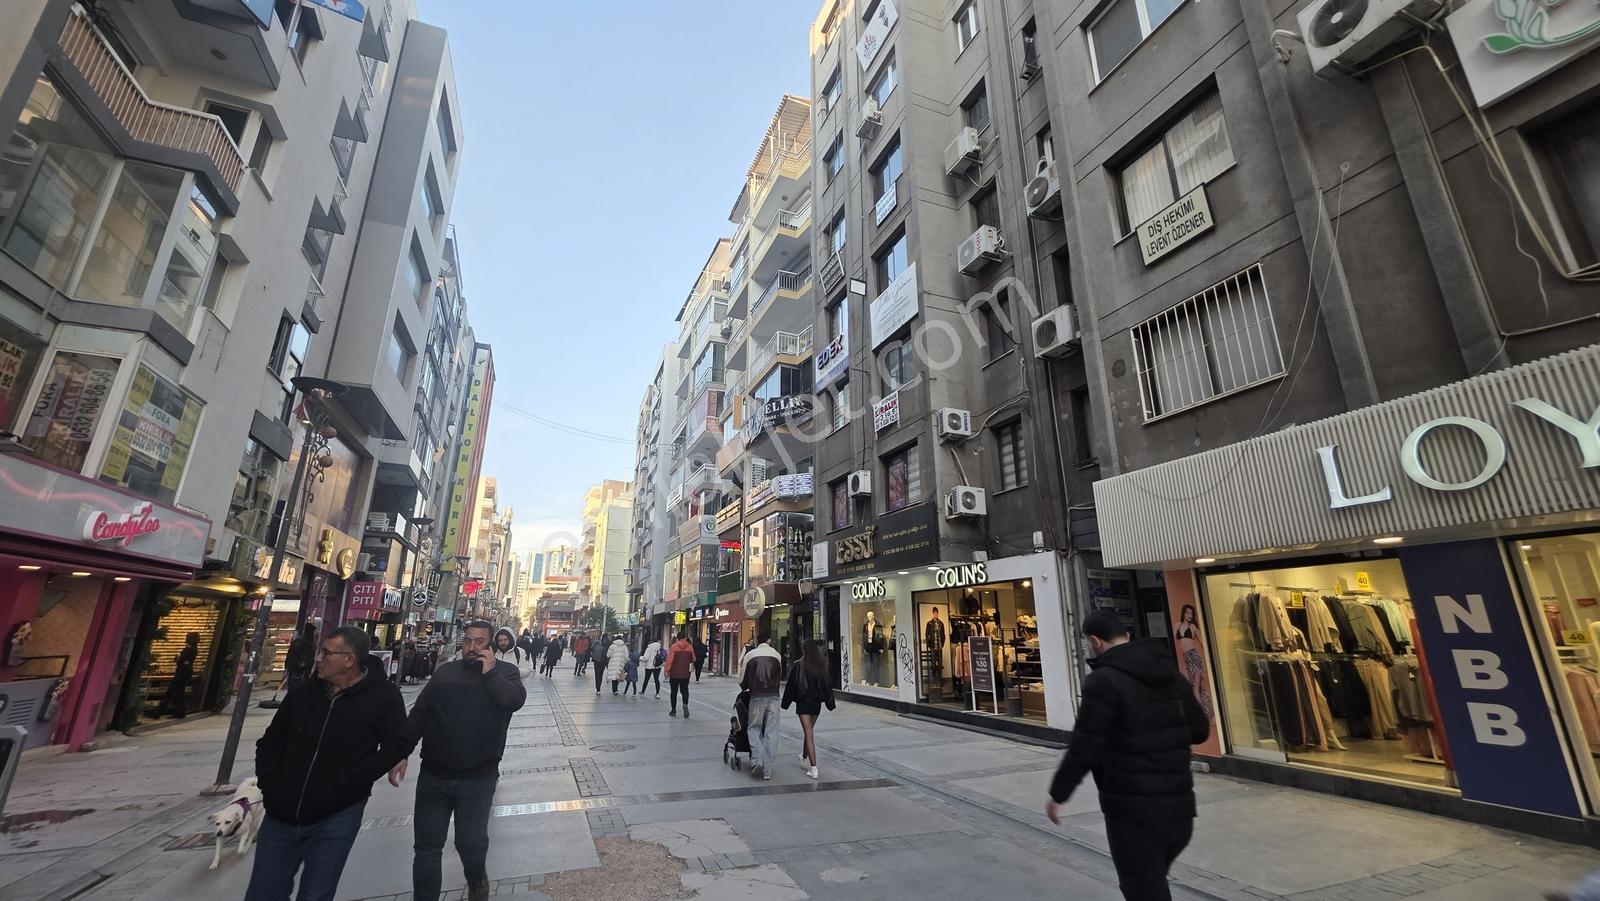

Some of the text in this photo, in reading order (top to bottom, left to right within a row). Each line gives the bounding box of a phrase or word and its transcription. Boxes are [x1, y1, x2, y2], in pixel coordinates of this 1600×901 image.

[1146, 211, 1206, 257] LEVENT ÖZDENER
[1148, 195, 1195, 238] DİŞ HEKİMİ
[35, 381, 58, 418] FORA
[151, 407, 171, 426] FORA
[449, 379, 481, 536] DALTON KURS
[1315, 397, 1600, 508] LOY
[852, 579, 885, 599] COLIN'S
[936, 562, 986, 588] COLIN'S
[1434, 594, 1526, 746] NBB
